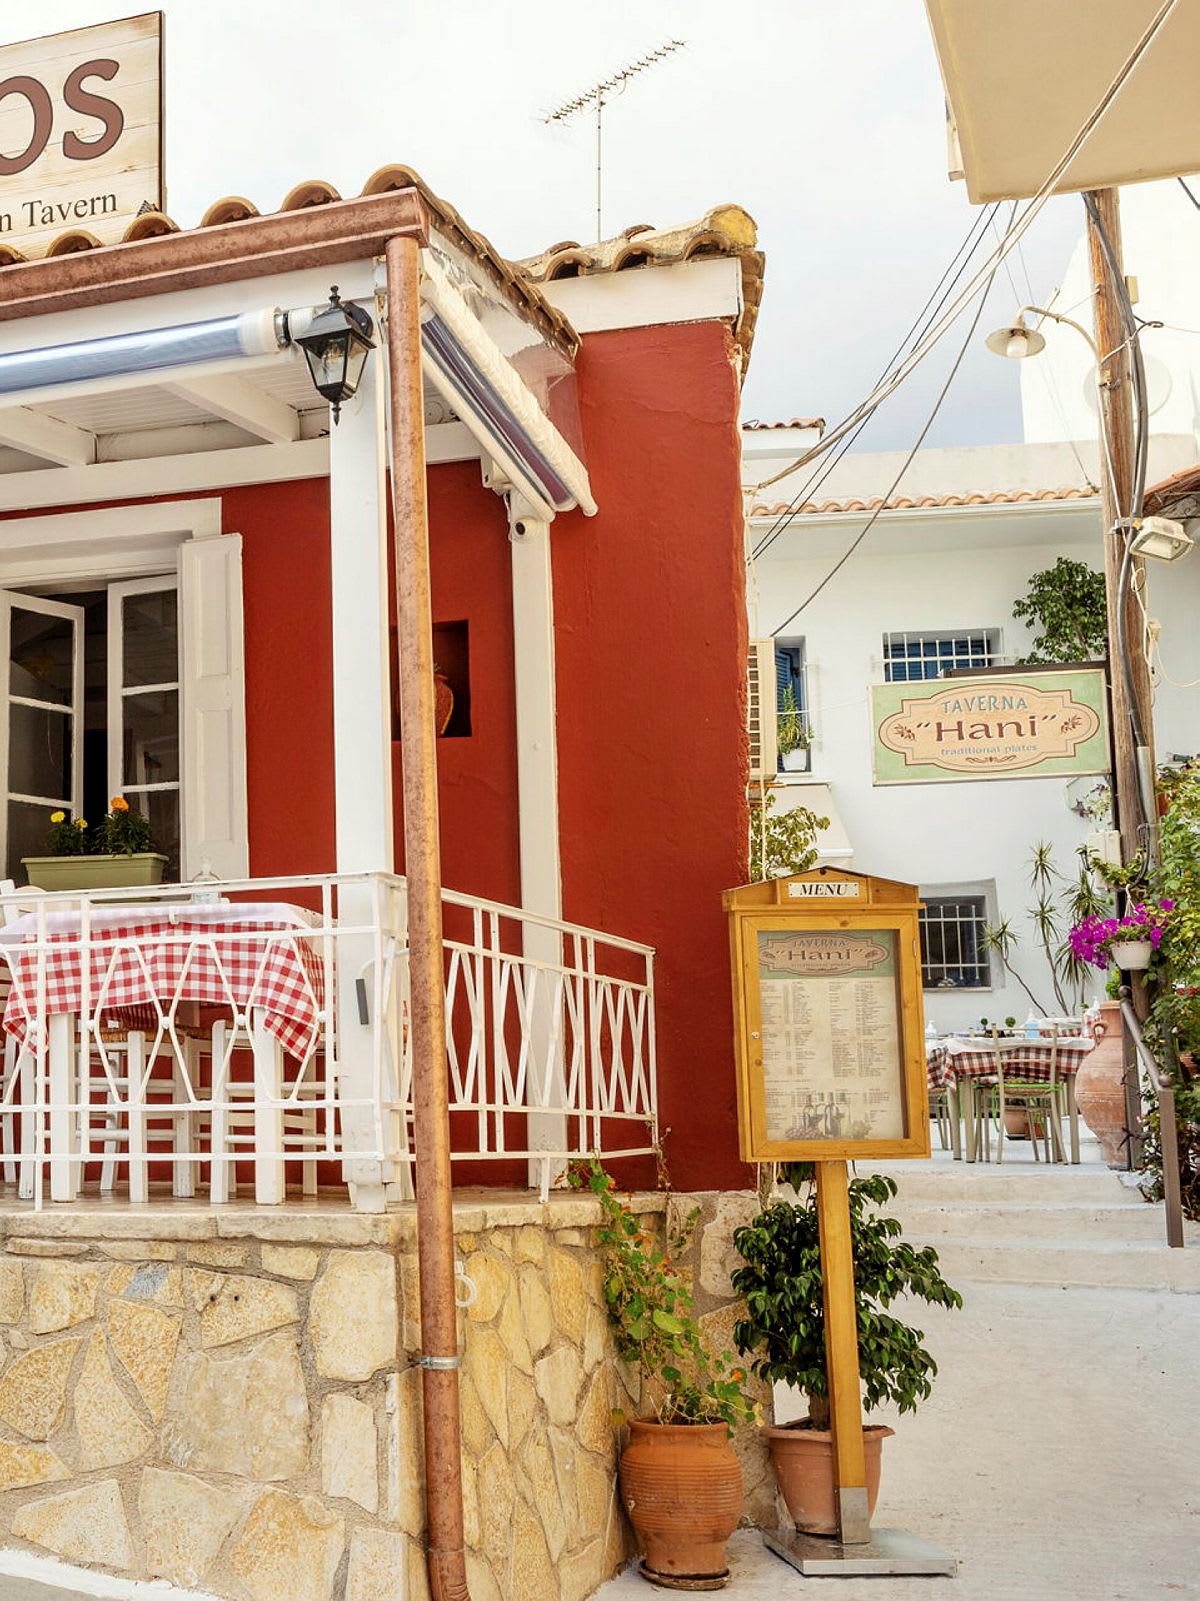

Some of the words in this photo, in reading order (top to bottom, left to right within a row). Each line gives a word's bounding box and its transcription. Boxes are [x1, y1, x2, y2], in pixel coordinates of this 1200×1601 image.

[21, 191, 118, 228] Tavern
[941, 695, 1028, 713] TAVERNA
[941, 746, 1000, 756] traditional
[1005, 744, 1037, 754] plates
[800, 884, 848, 895] MENU
